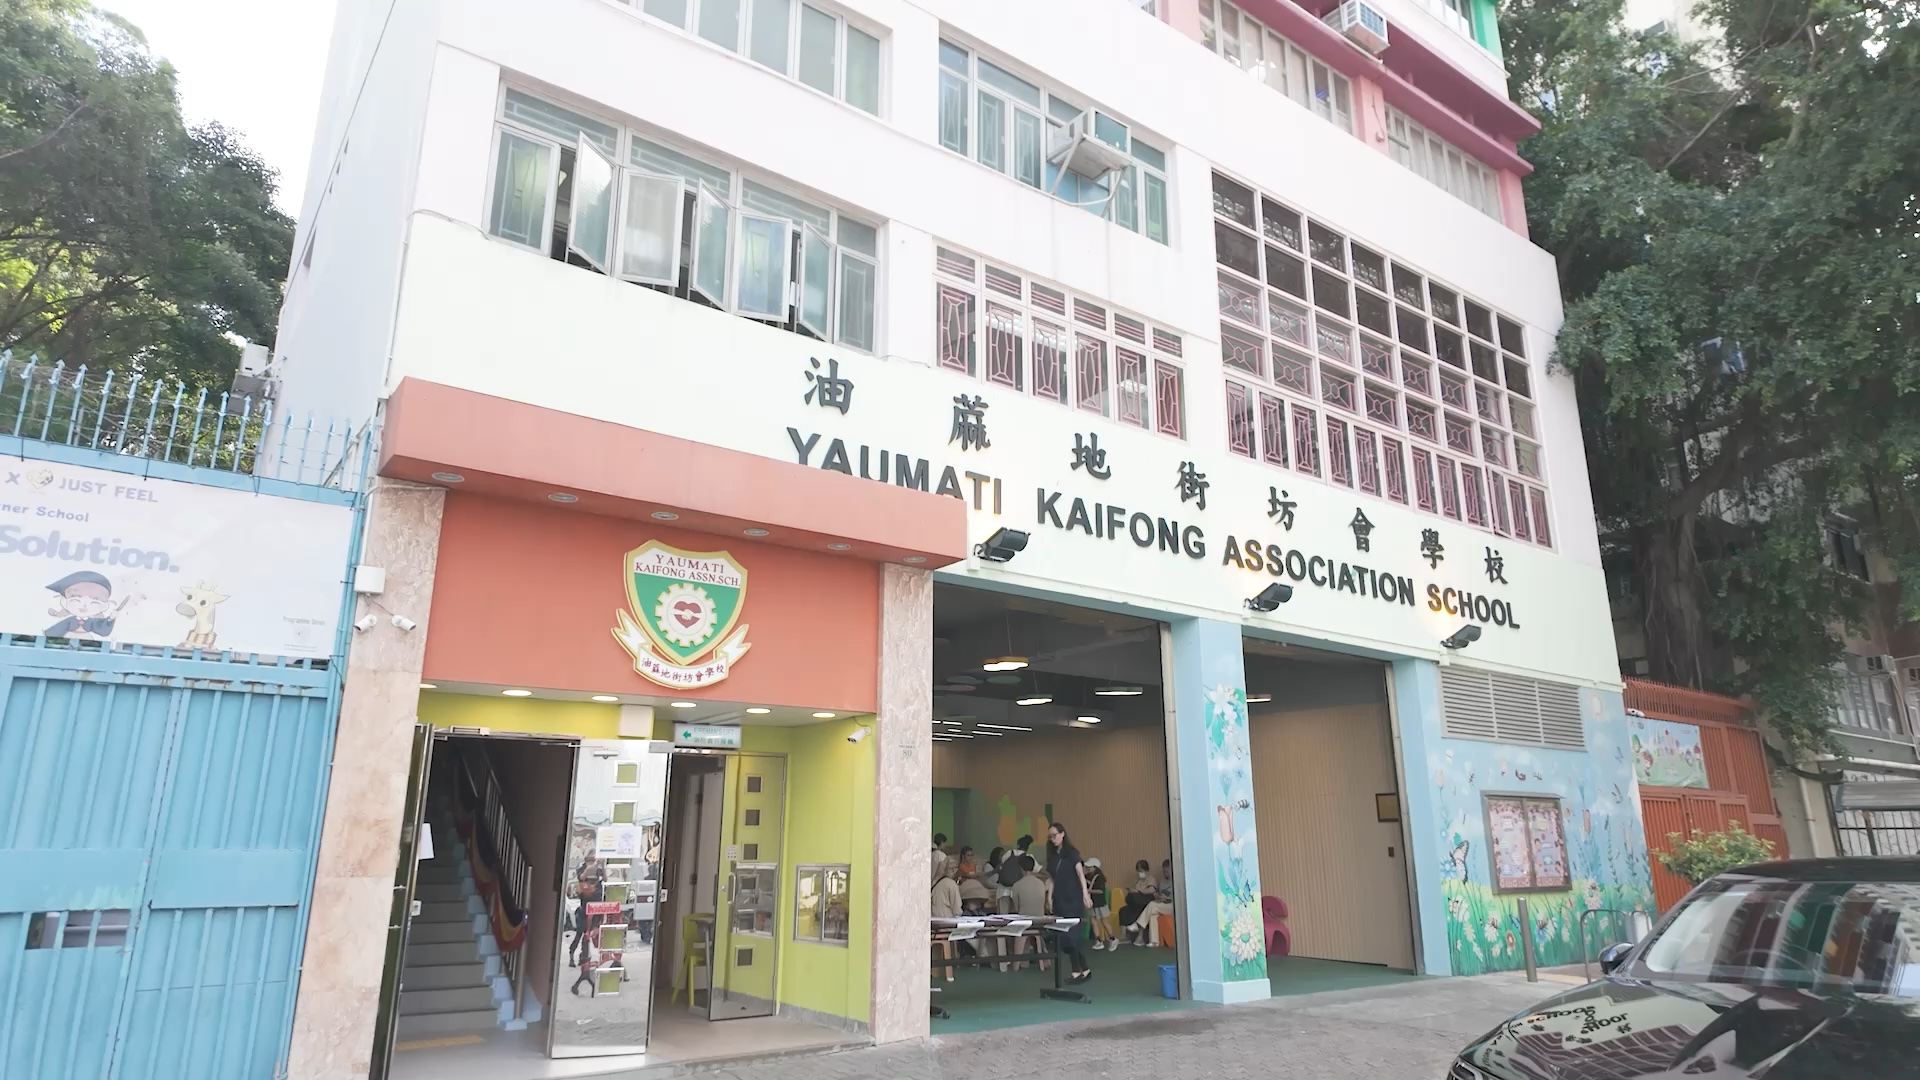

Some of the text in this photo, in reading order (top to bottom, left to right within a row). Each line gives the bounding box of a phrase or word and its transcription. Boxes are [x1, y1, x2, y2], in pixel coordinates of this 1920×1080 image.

[58, 477, 108, 495] JUST
[114, 486, 159, 503] FEEL
[0, 503, 90, 523] ner School
[786, 427, 1521, 630] YAUMATI KAIFONG ASSOCIATION SCHOOL
[0, 524, 181, 573] Solution.
[635, 561, 686, 579] KAIFONG
[655, 553, 725, 574] YAUMATI
